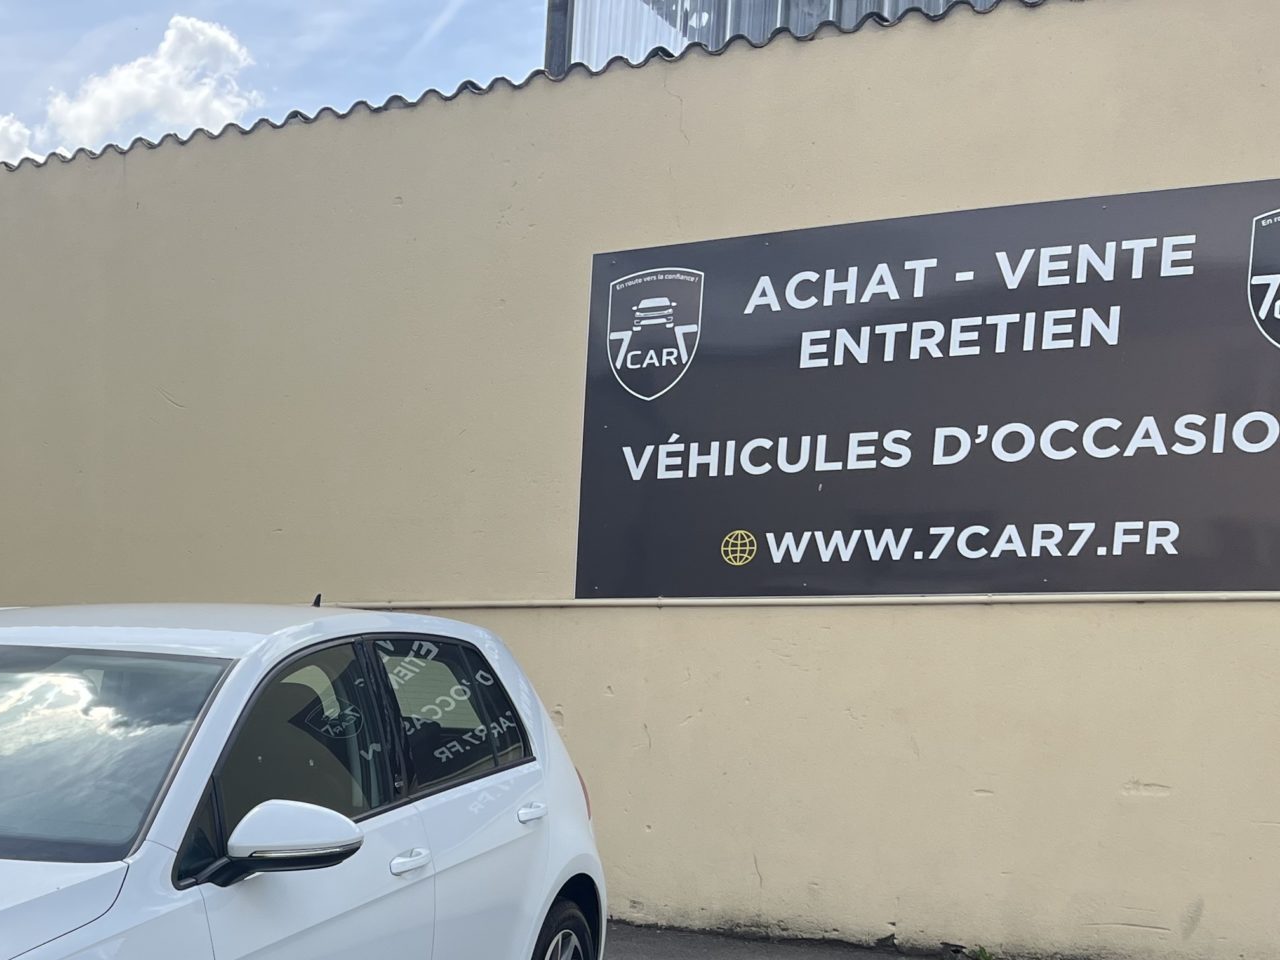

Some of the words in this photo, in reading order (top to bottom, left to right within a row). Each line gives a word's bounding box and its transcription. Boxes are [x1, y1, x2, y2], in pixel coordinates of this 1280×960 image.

[744, 258, 937, 314] ACHAT
[995, 234, 1196, 290] VENTE
[799, 305, 1121, 369] ENTRETIEN
[622, 428, 912, 481] VÉHICULES
[766, 520, 1179, 564] WWW.7CAR7.FR
